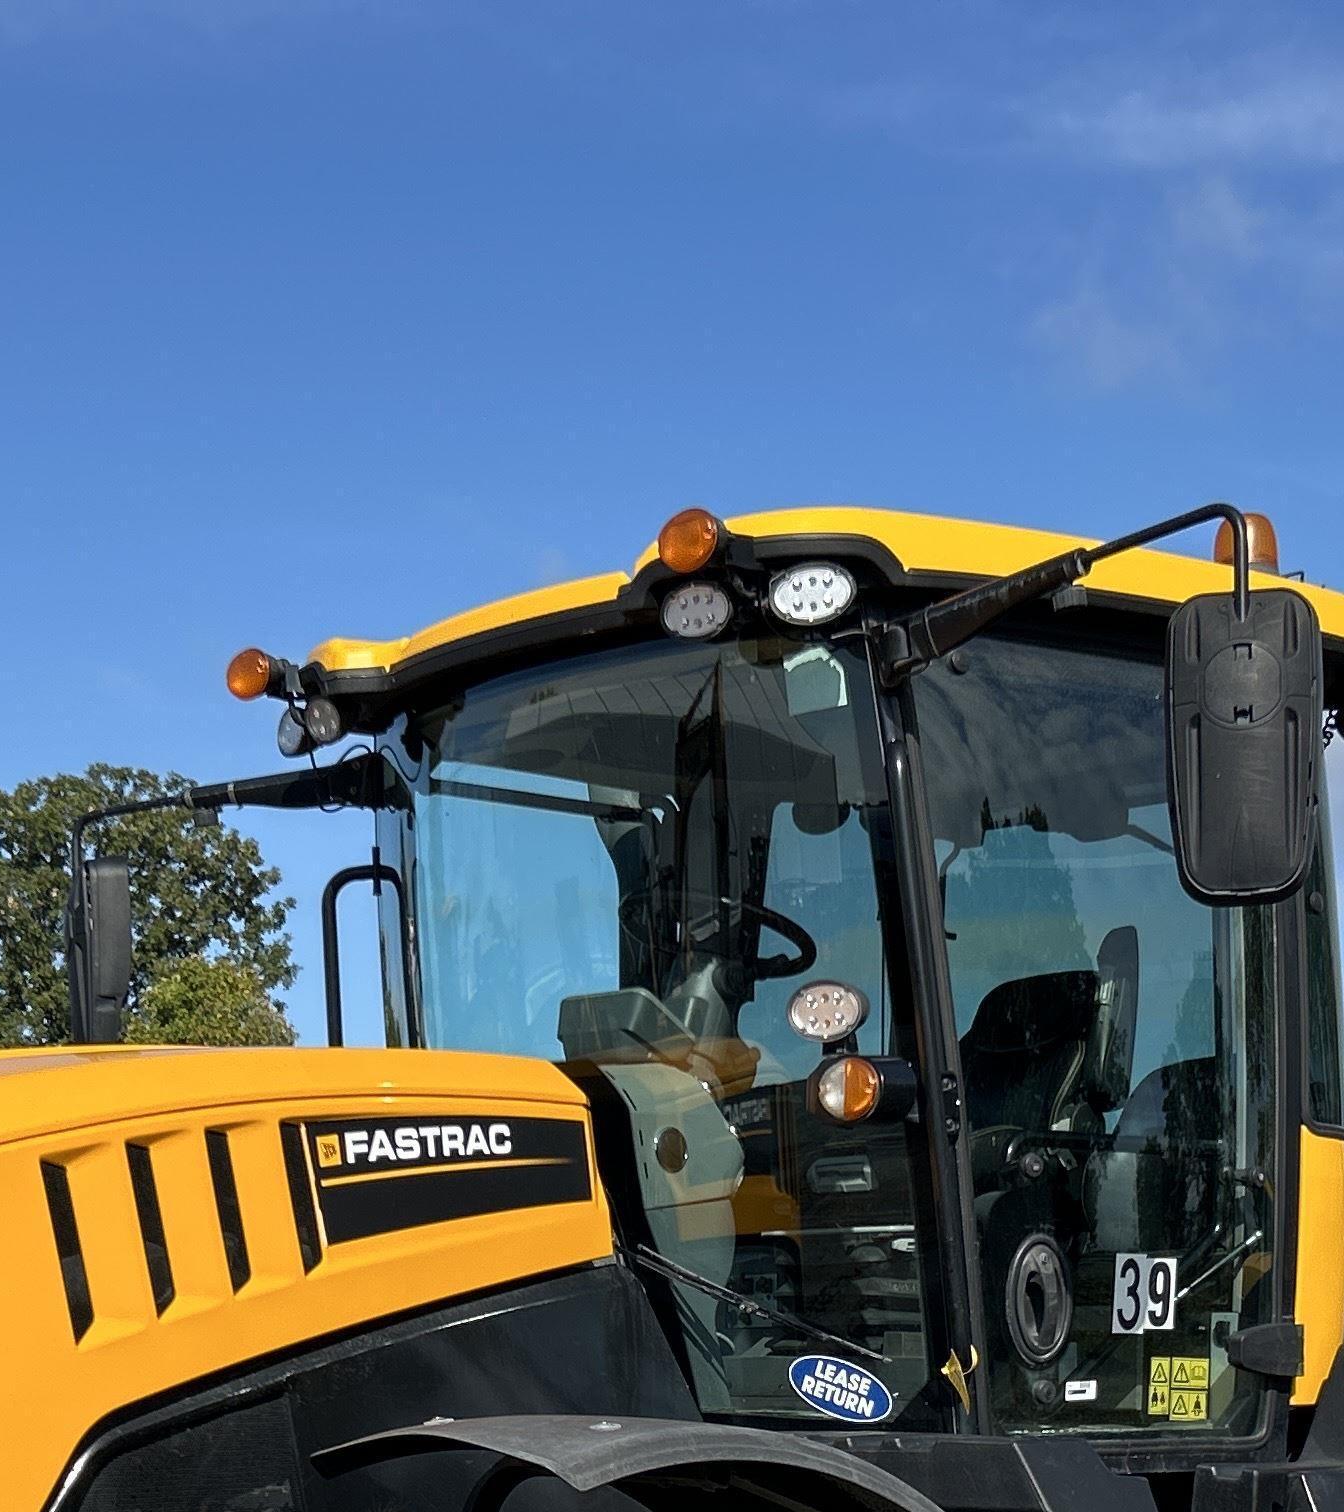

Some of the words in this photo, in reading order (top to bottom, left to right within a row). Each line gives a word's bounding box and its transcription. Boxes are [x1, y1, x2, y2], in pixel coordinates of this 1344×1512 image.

[344, 1124, 512, 1164] FASTRAC
[1117, 1257, 1171, 1331] 39
[801, 1374, 875, 1418] RETURN
[814, 1359, 872, 1397] LEASE
